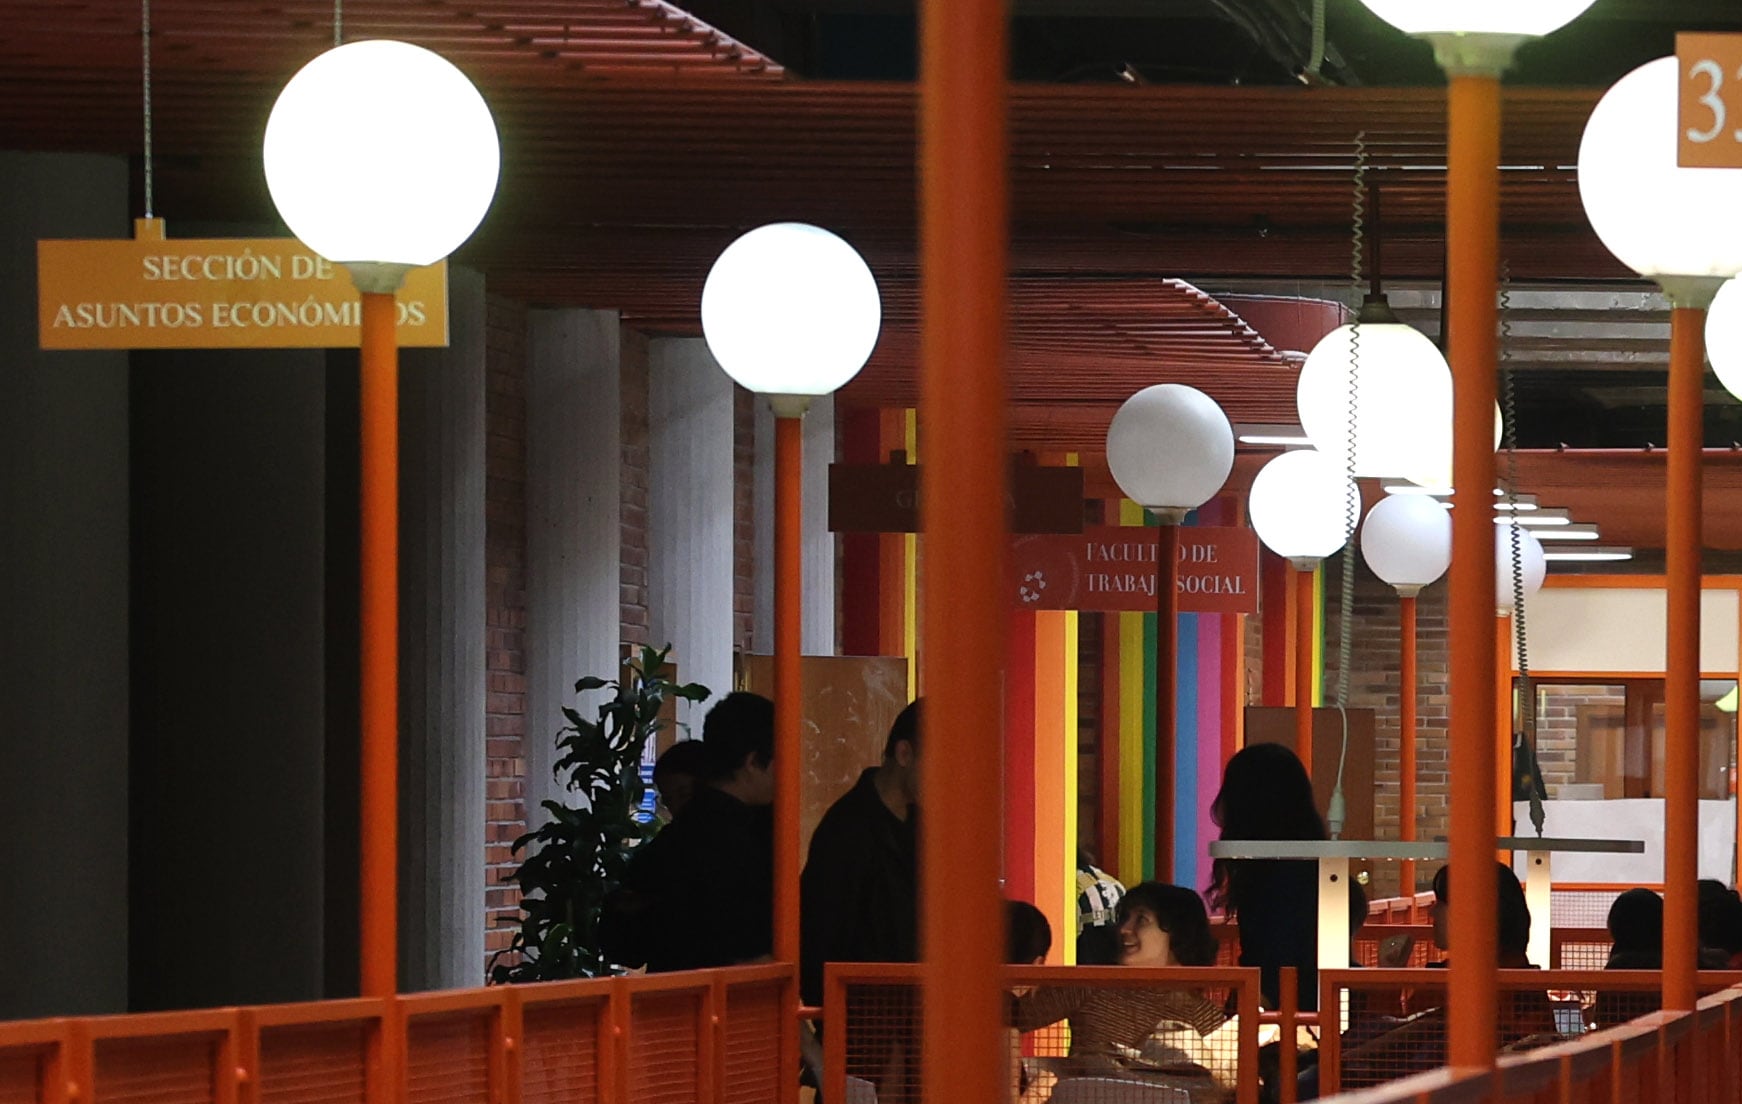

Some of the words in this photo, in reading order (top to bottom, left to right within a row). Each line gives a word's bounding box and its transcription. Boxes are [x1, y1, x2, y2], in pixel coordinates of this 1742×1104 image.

[142, 247, 281, 281] SECCIÓN
[291, 254, 335, 280] DE
[53, 302, 203, 328] ASUNTOS
[212, 295, 427, 328] ECONÓMIOS
[1086, 542, 1188, 562] FACULTD
[1192, 544, 1218, 563] DE
[1086, 573, 1159, 596] TRABAJ
[1177, 575, 1246, 595] SOCIAL
